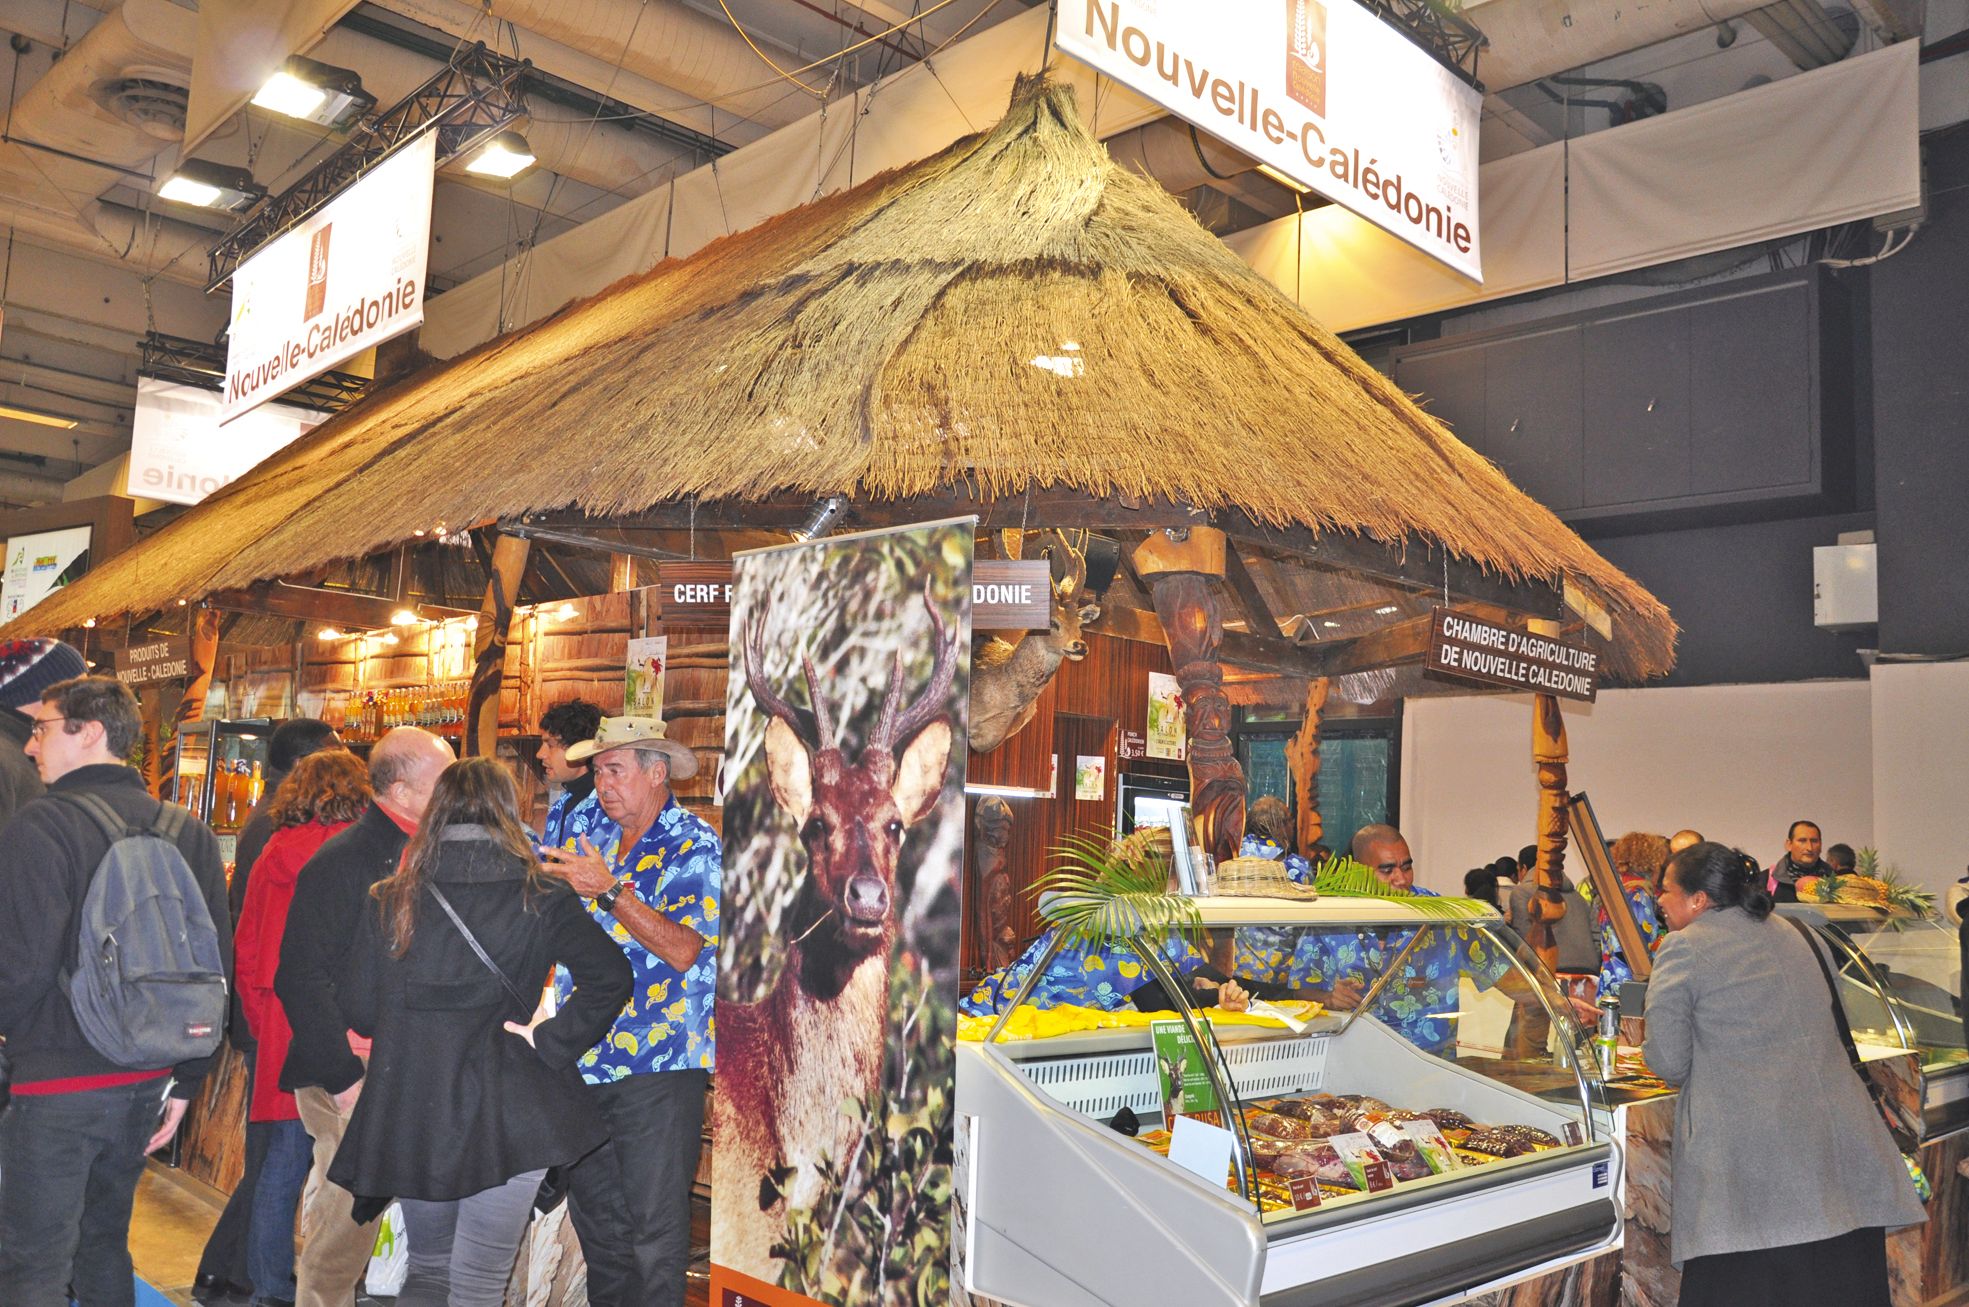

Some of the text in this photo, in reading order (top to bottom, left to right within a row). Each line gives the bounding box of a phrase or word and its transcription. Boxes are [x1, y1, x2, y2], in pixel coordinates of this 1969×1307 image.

[1085, 0, 1472, 253] Nouvelle-Calédonie
[229, 277, 416, 404] Nouvelle-Calédonie
[674, 584, 719, 603] CERF
[973, 584, 1032, 604] DONIE
[129, 642, 169, 664] PRODUITS DE
[1443, 616, 1597, 672] CHAMBRE D'AGRICULTURE
[117, 667, 148, 684] NOUVELLE
[151, 660, 187, 679] CALEDONIE
[1440, 644, 1592, 696] DE NOUVELLE CALEDONIE
[1155, 1024, 1185, 1034] UNE VIANDE
